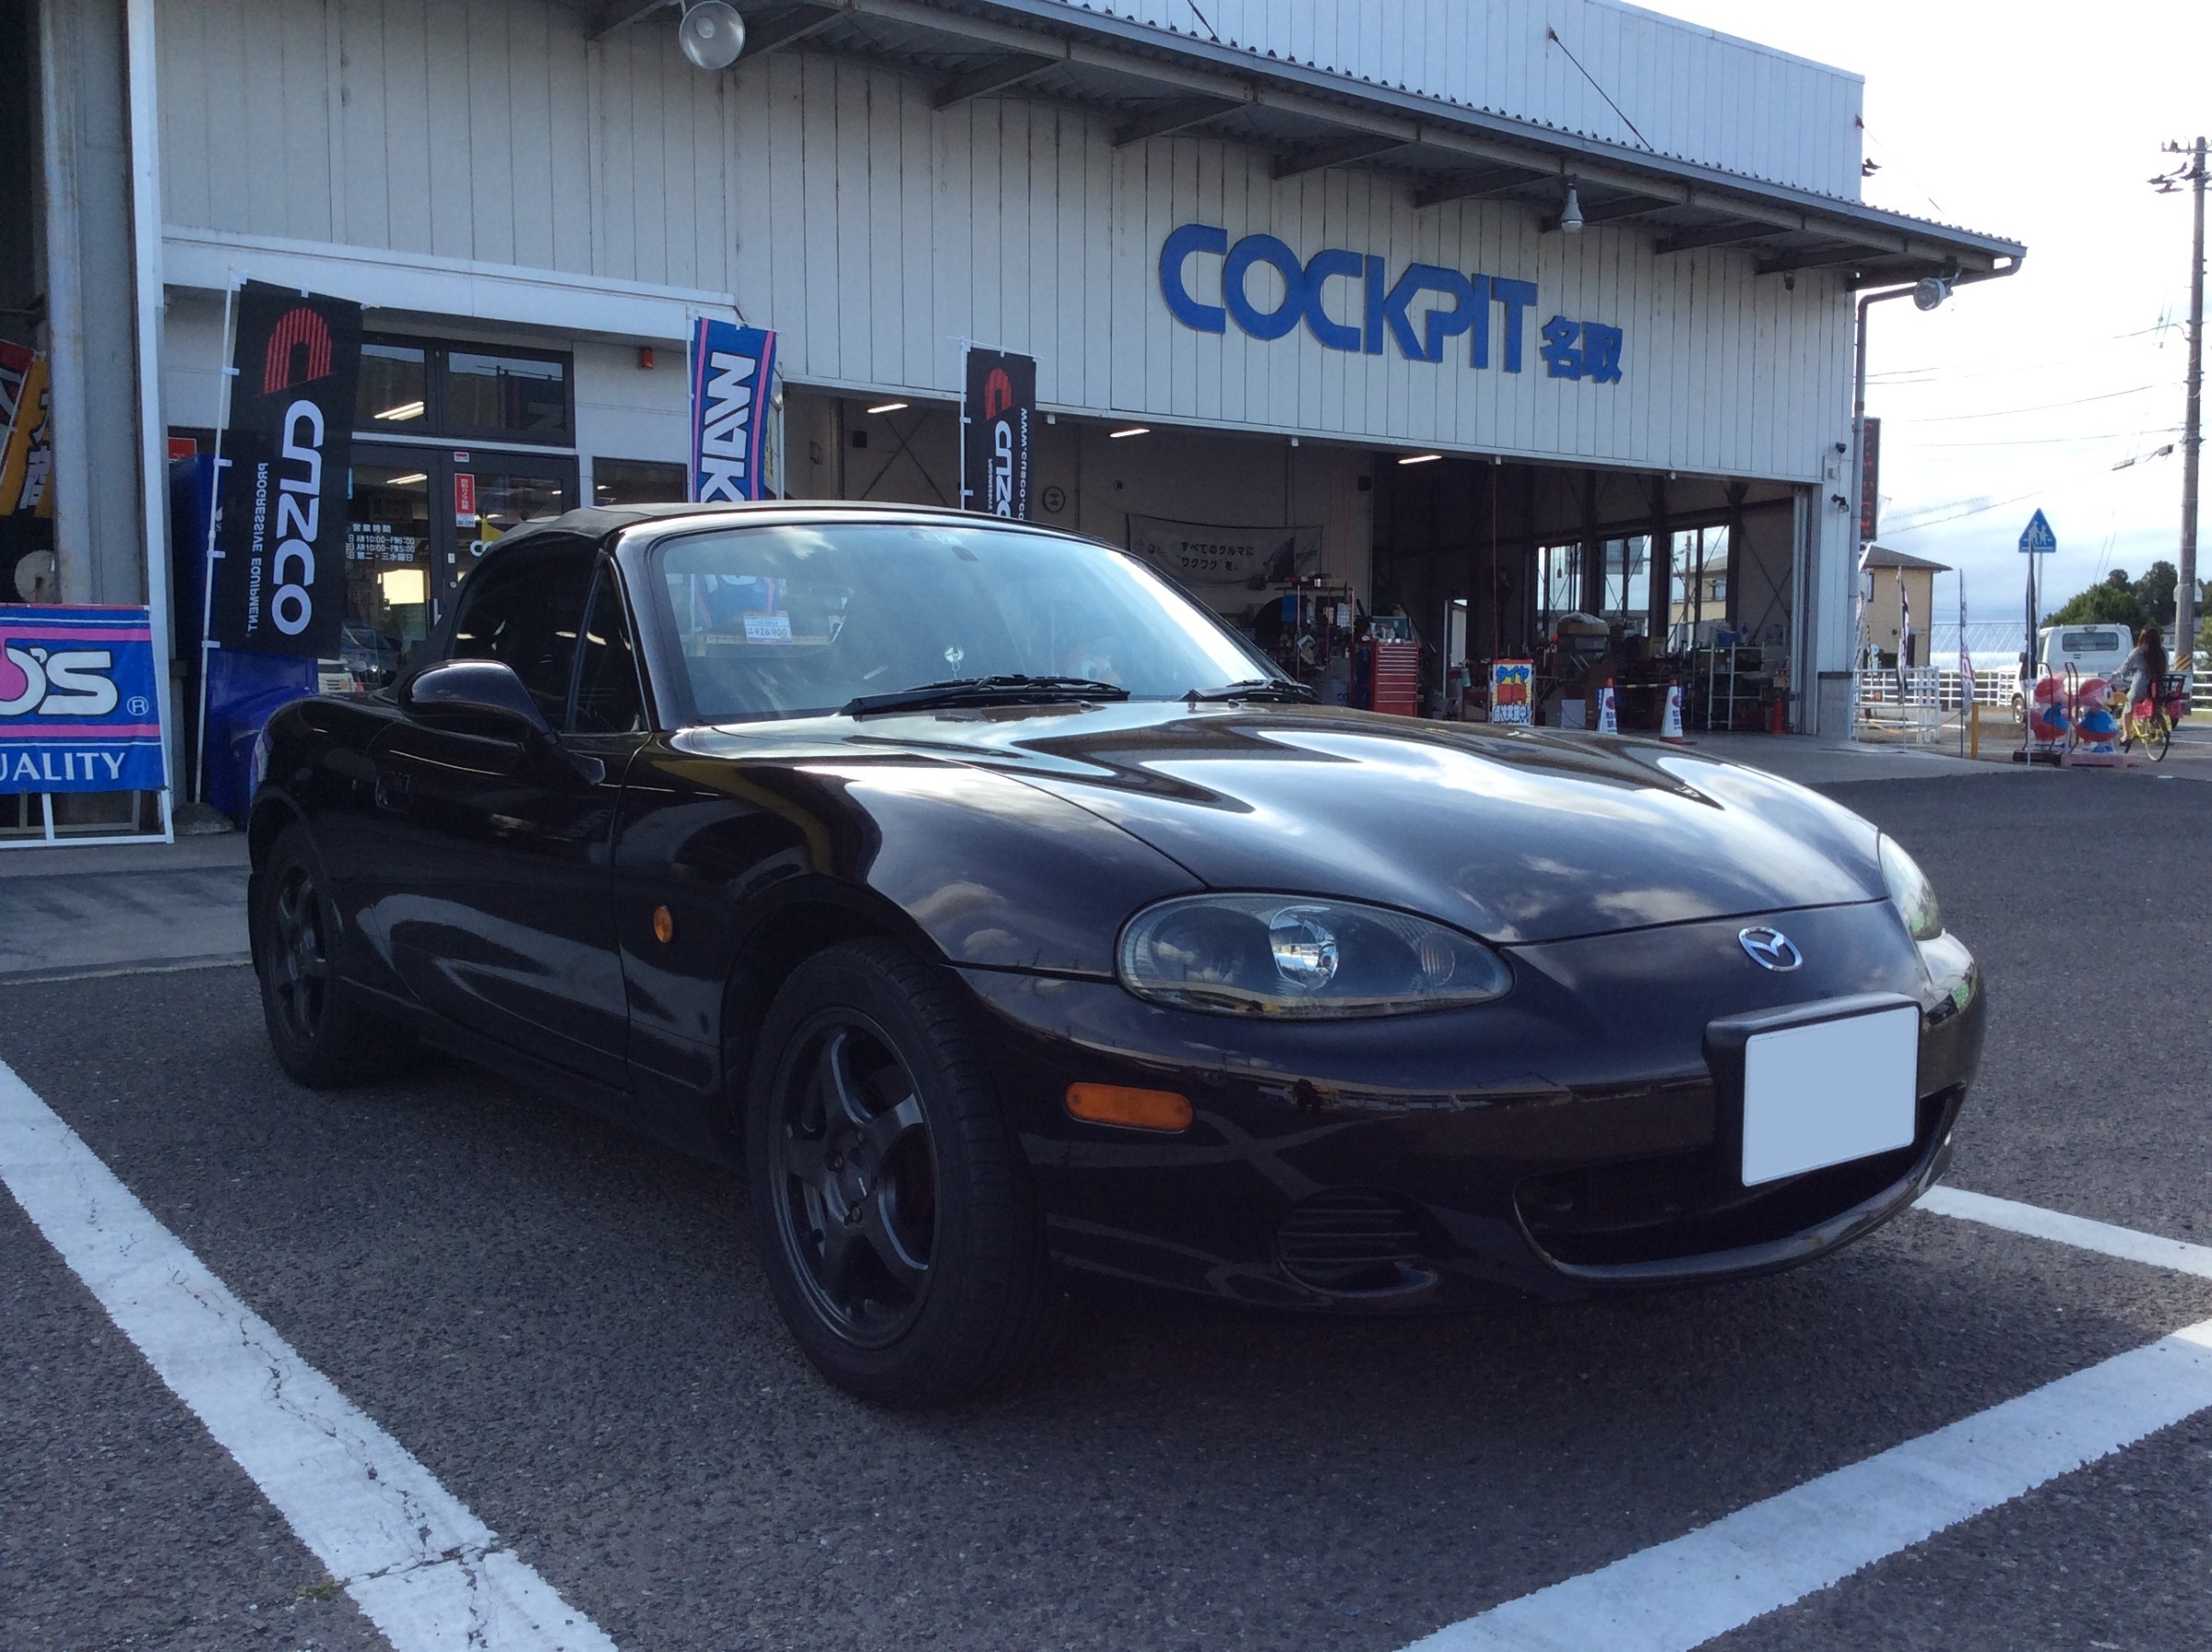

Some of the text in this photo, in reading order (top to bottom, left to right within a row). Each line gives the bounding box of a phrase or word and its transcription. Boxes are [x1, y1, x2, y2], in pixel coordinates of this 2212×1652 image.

[1159, 224, 1623, 384] COCKPIT 名取
[1180, 541, 1255, 557] すべてのクルマに
[0, 751, 126, 782] ALITY
